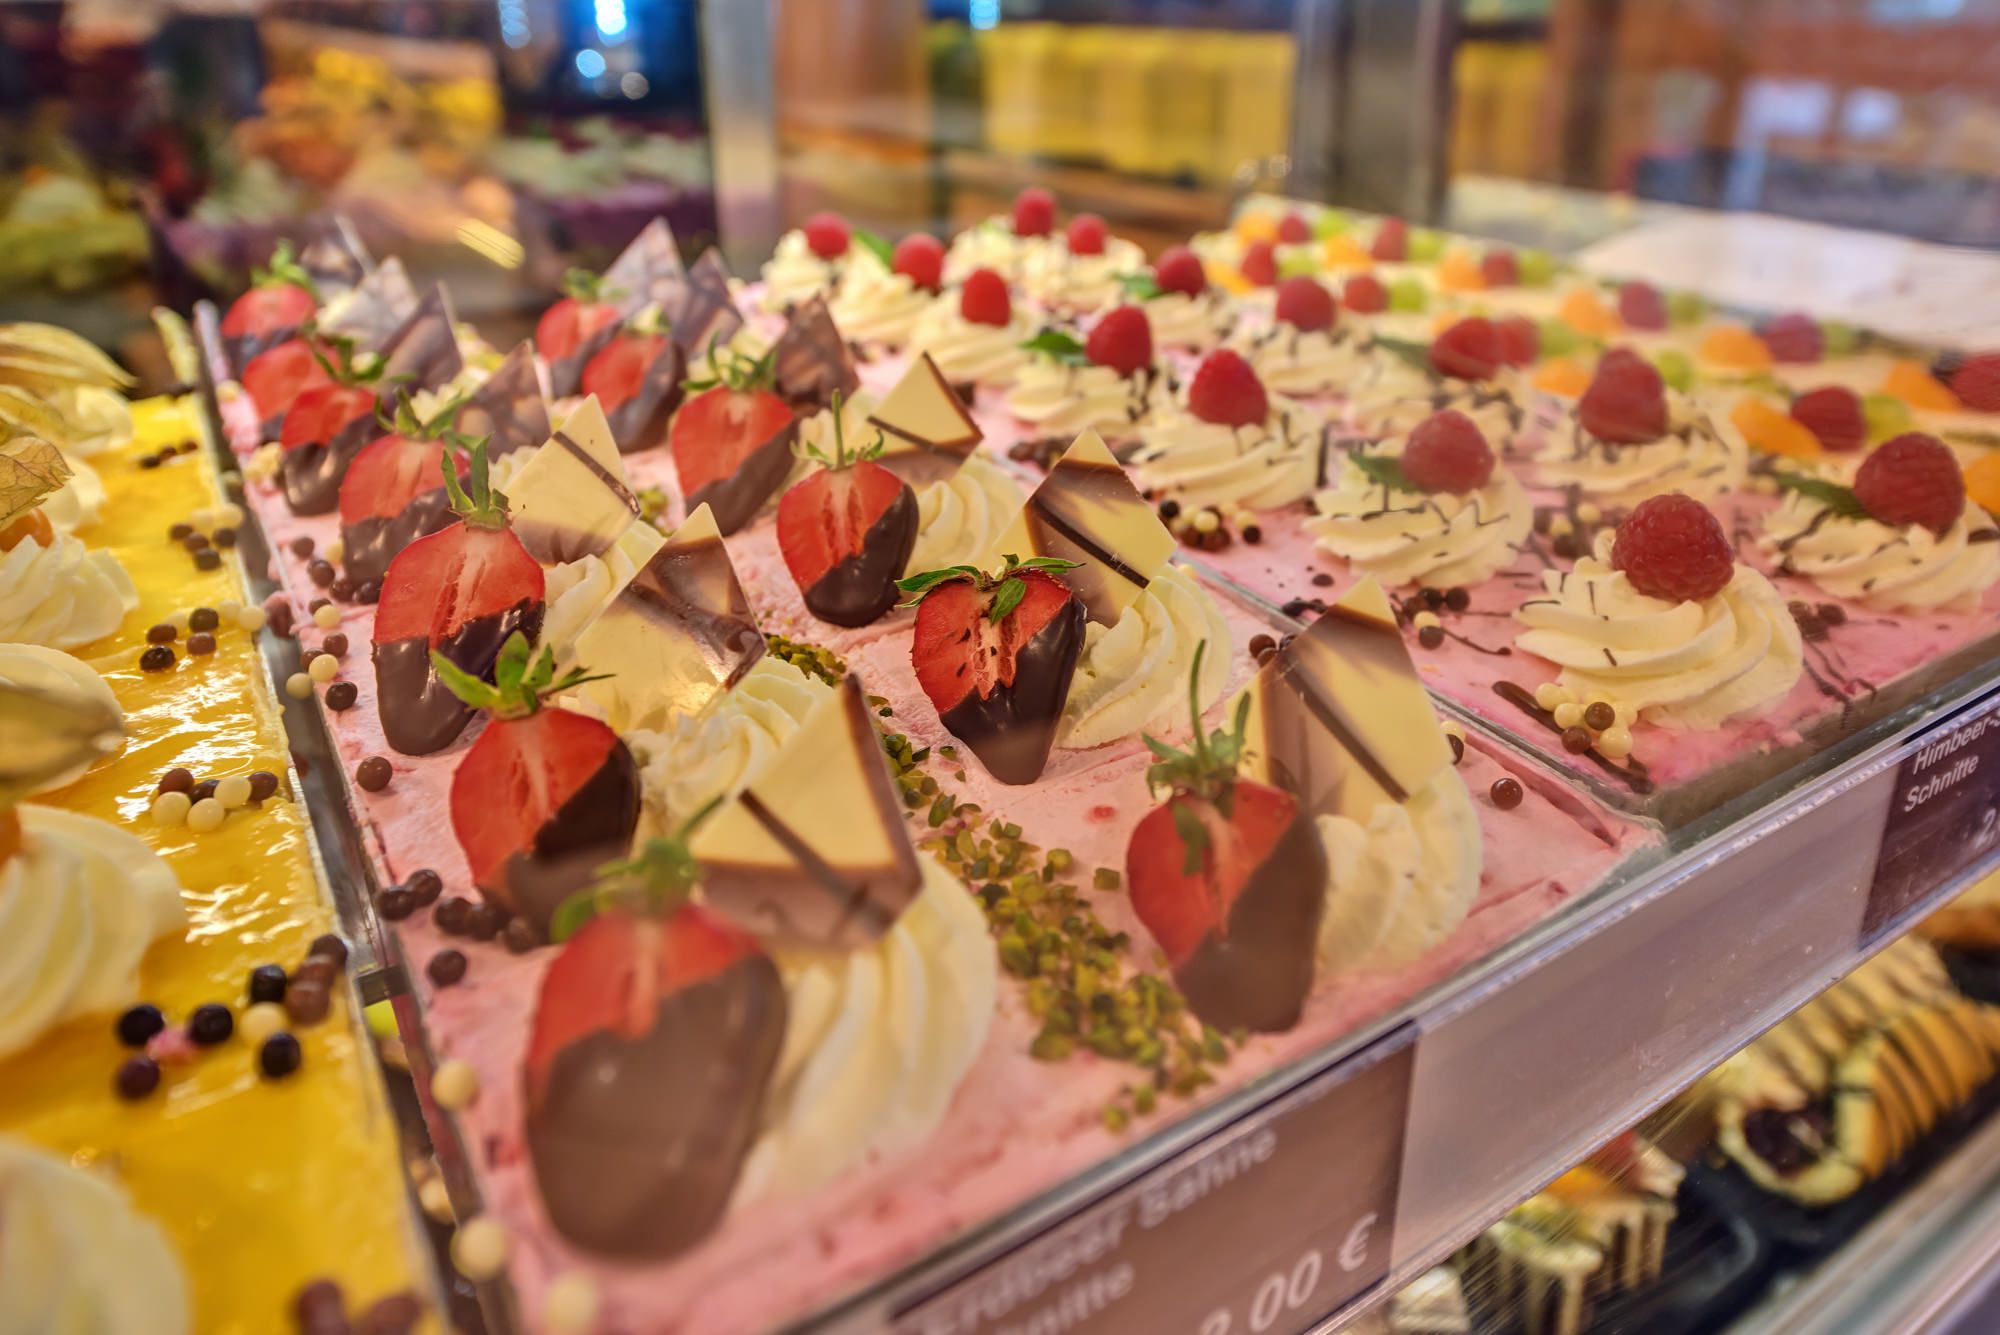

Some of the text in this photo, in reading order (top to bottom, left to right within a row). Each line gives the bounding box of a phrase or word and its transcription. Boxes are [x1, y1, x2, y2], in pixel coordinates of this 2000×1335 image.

[1904, 755, 1979, 812] Schnitte
[1137, 1126, 1278, 1229] Sahne
[1337, 1211, 1378, 1272] €
